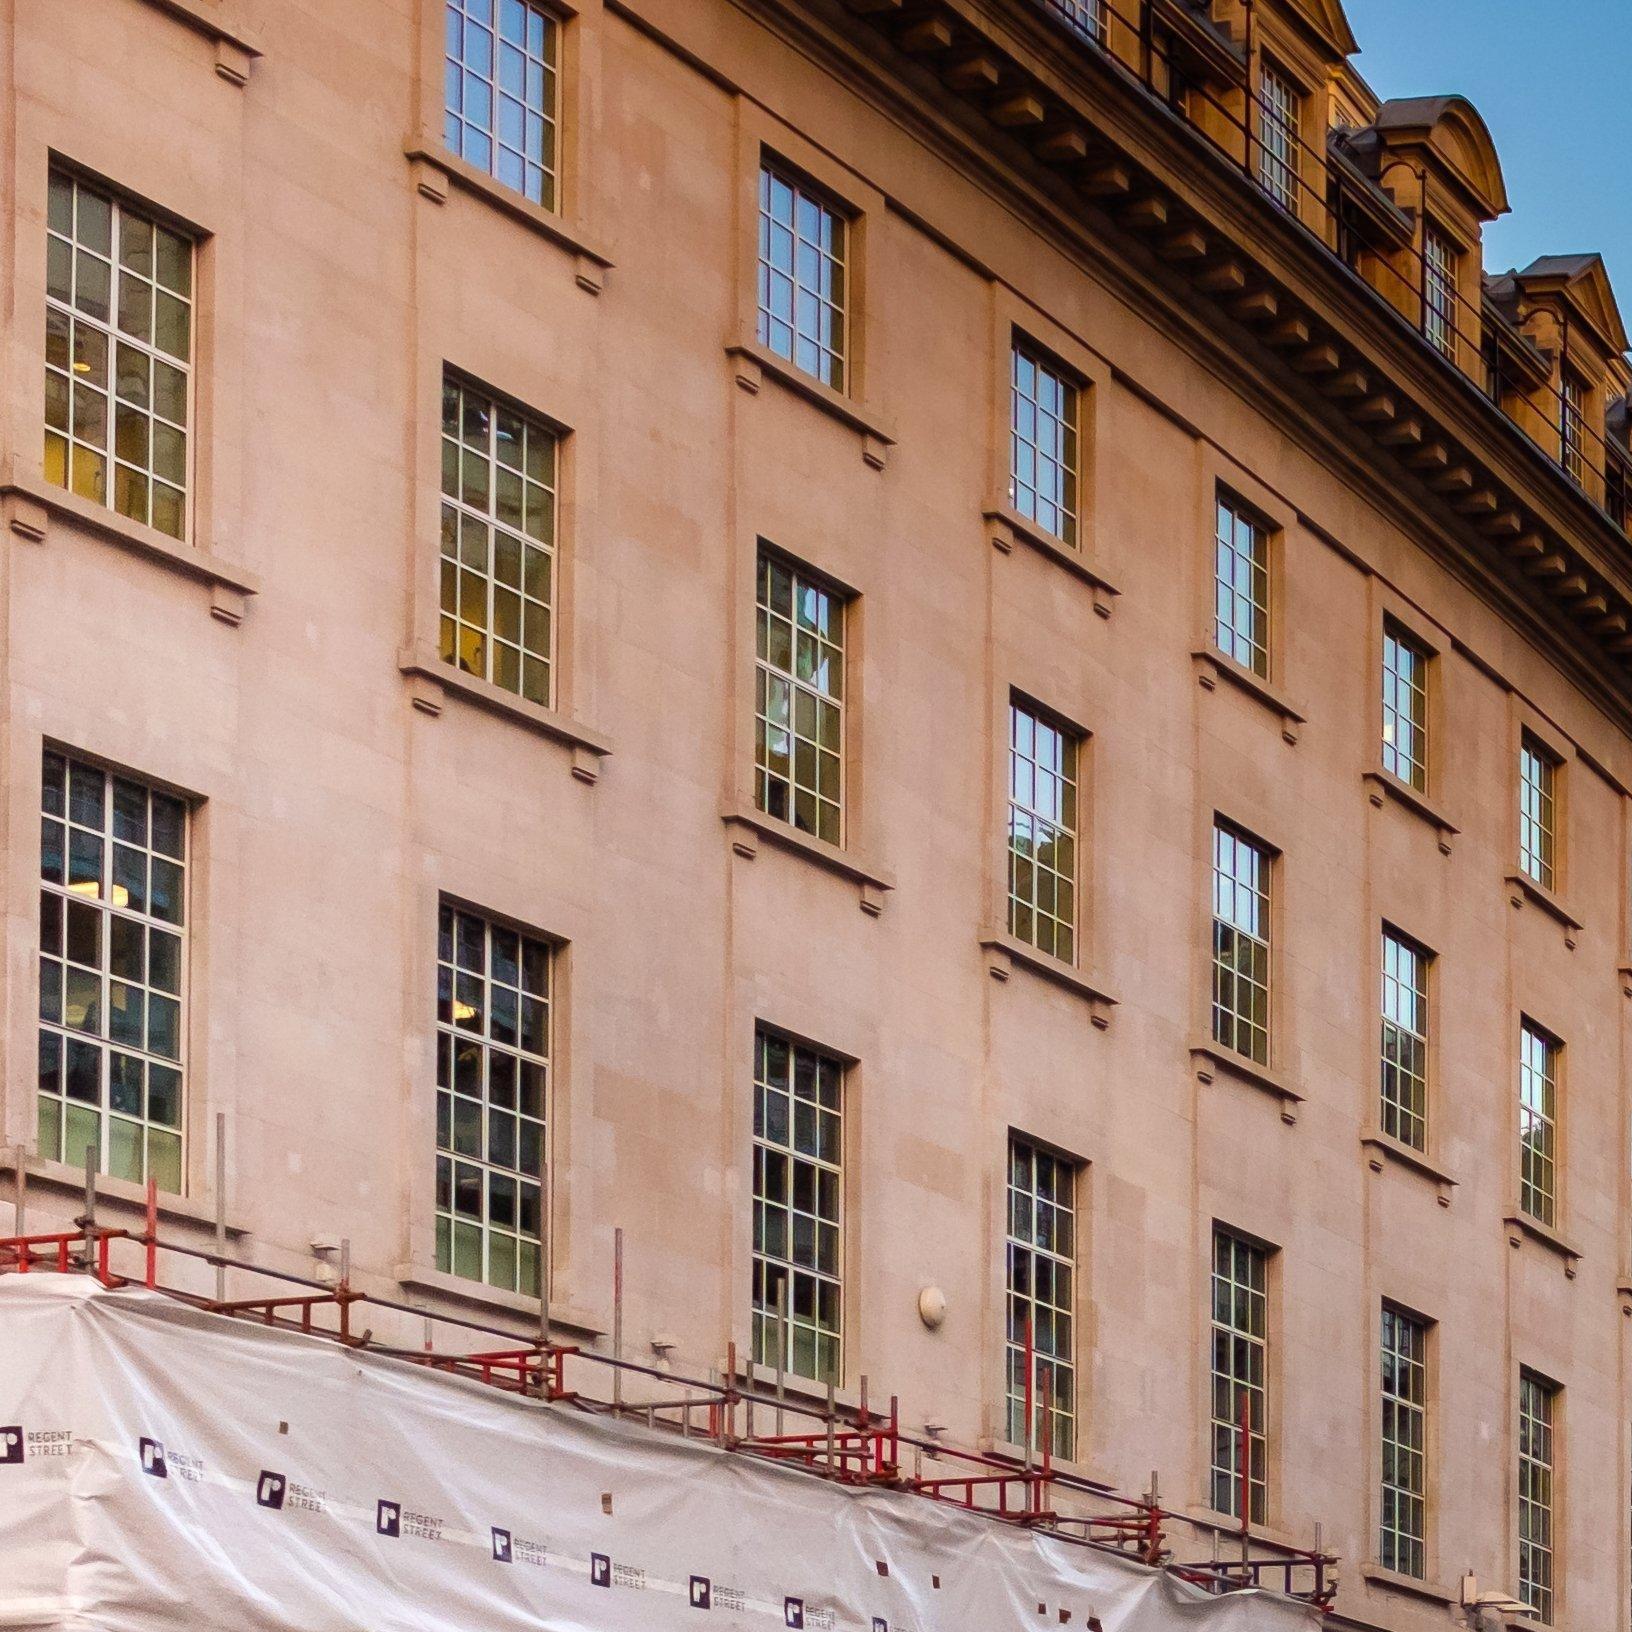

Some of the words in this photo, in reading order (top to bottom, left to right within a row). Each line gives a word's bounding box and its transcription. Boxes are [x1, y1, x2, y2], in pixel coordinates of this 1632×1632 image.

[27, 1431, 73, 1443] REGENT
[29, 1444, 73, 1456] STREET
[403, 1512, 443, 1528] REGENT
[402, 1524, 442, 1540] STREET
